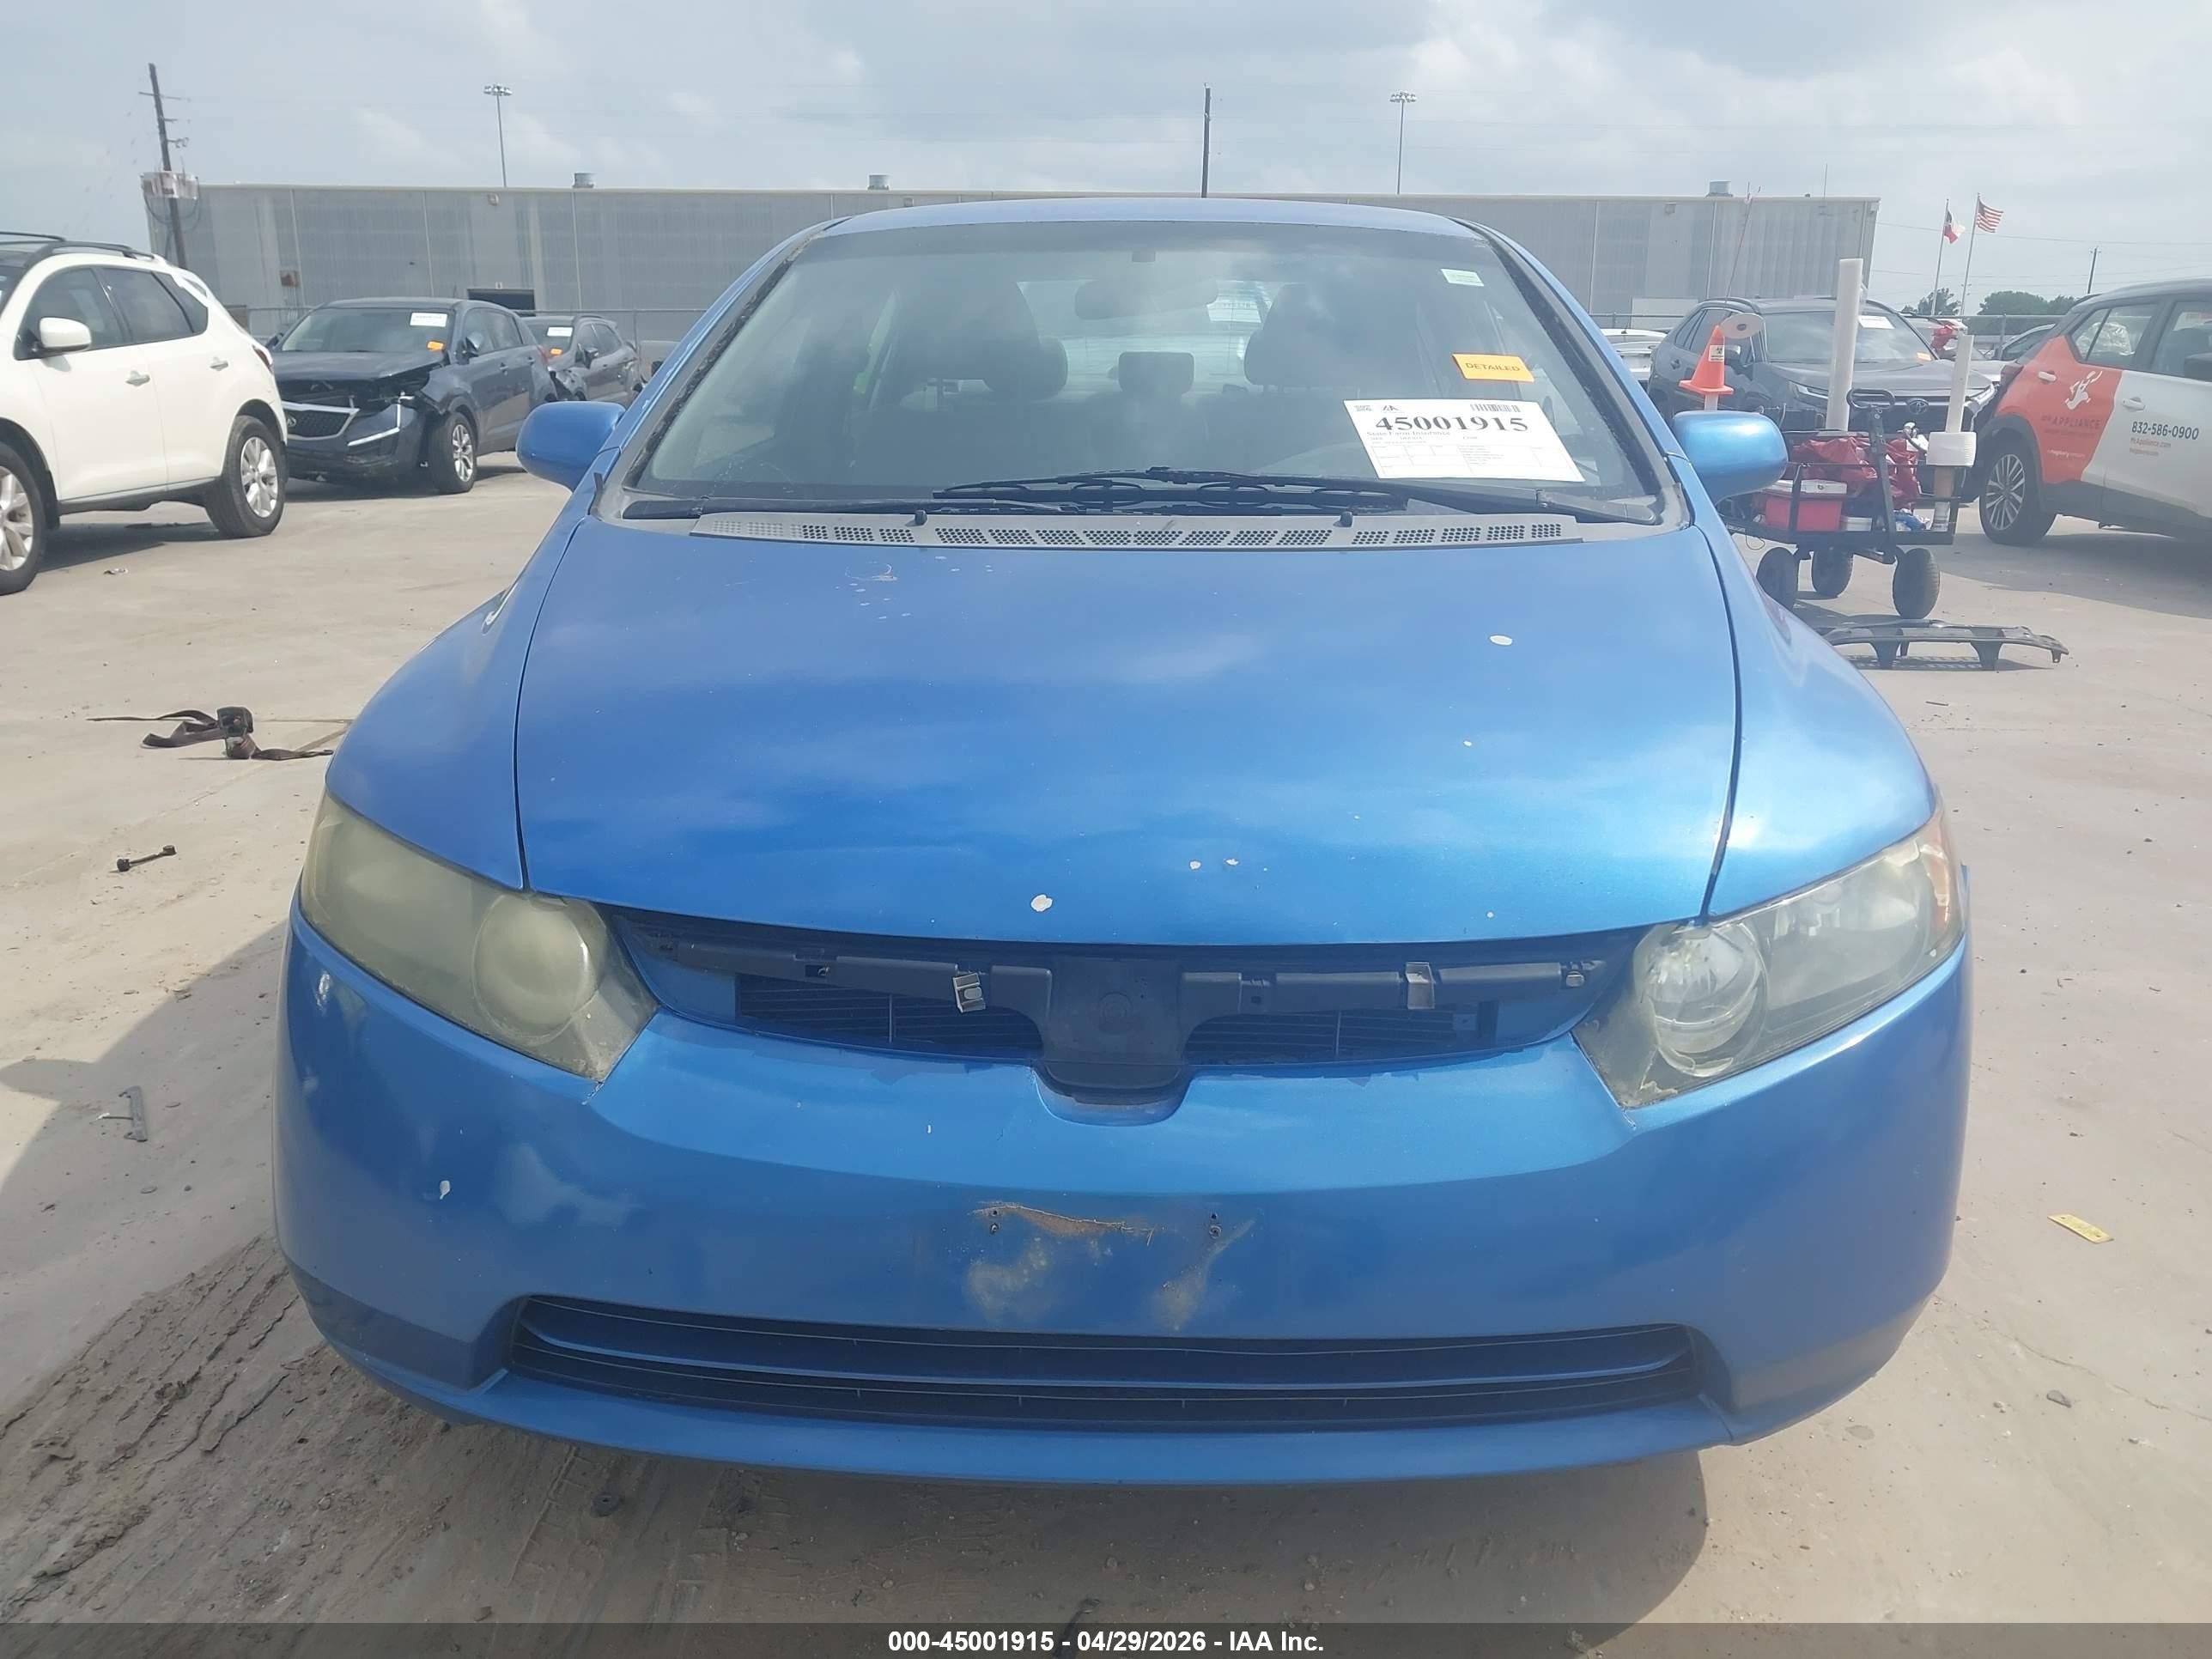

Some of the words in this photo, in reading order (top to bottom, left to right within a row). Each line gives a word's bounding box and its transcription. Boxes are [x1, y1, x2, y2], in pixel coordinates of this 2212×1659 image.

[1465, 362, 1521, 372] DETAILED
[1375, 416, 1528, 431] 45001915
[2131, 421, 2200, 440] 832-586-0900
